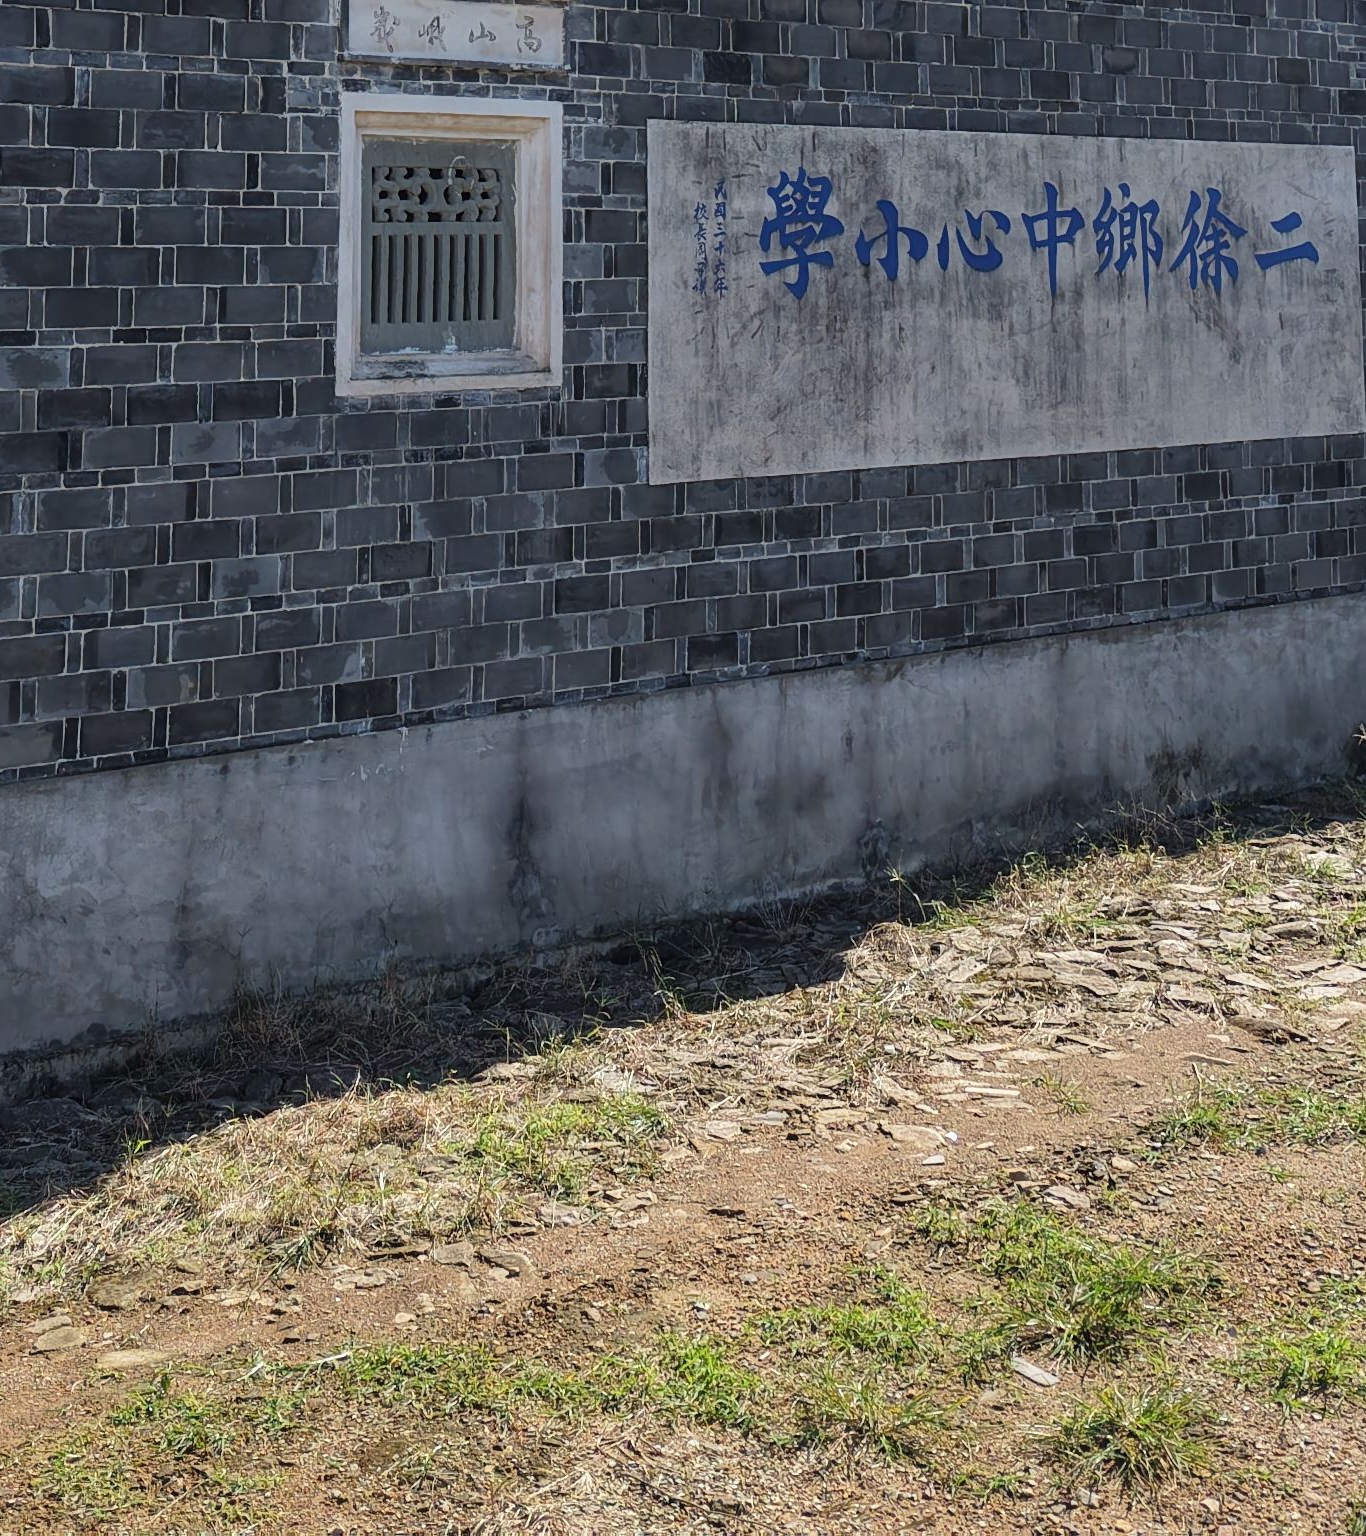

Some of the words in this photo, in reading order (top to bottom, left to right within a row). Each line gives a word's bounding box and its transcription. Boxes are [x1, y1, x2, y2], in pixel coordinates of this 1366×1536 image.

[759, 166, 1320, 305] 二徐鄉中心小學
